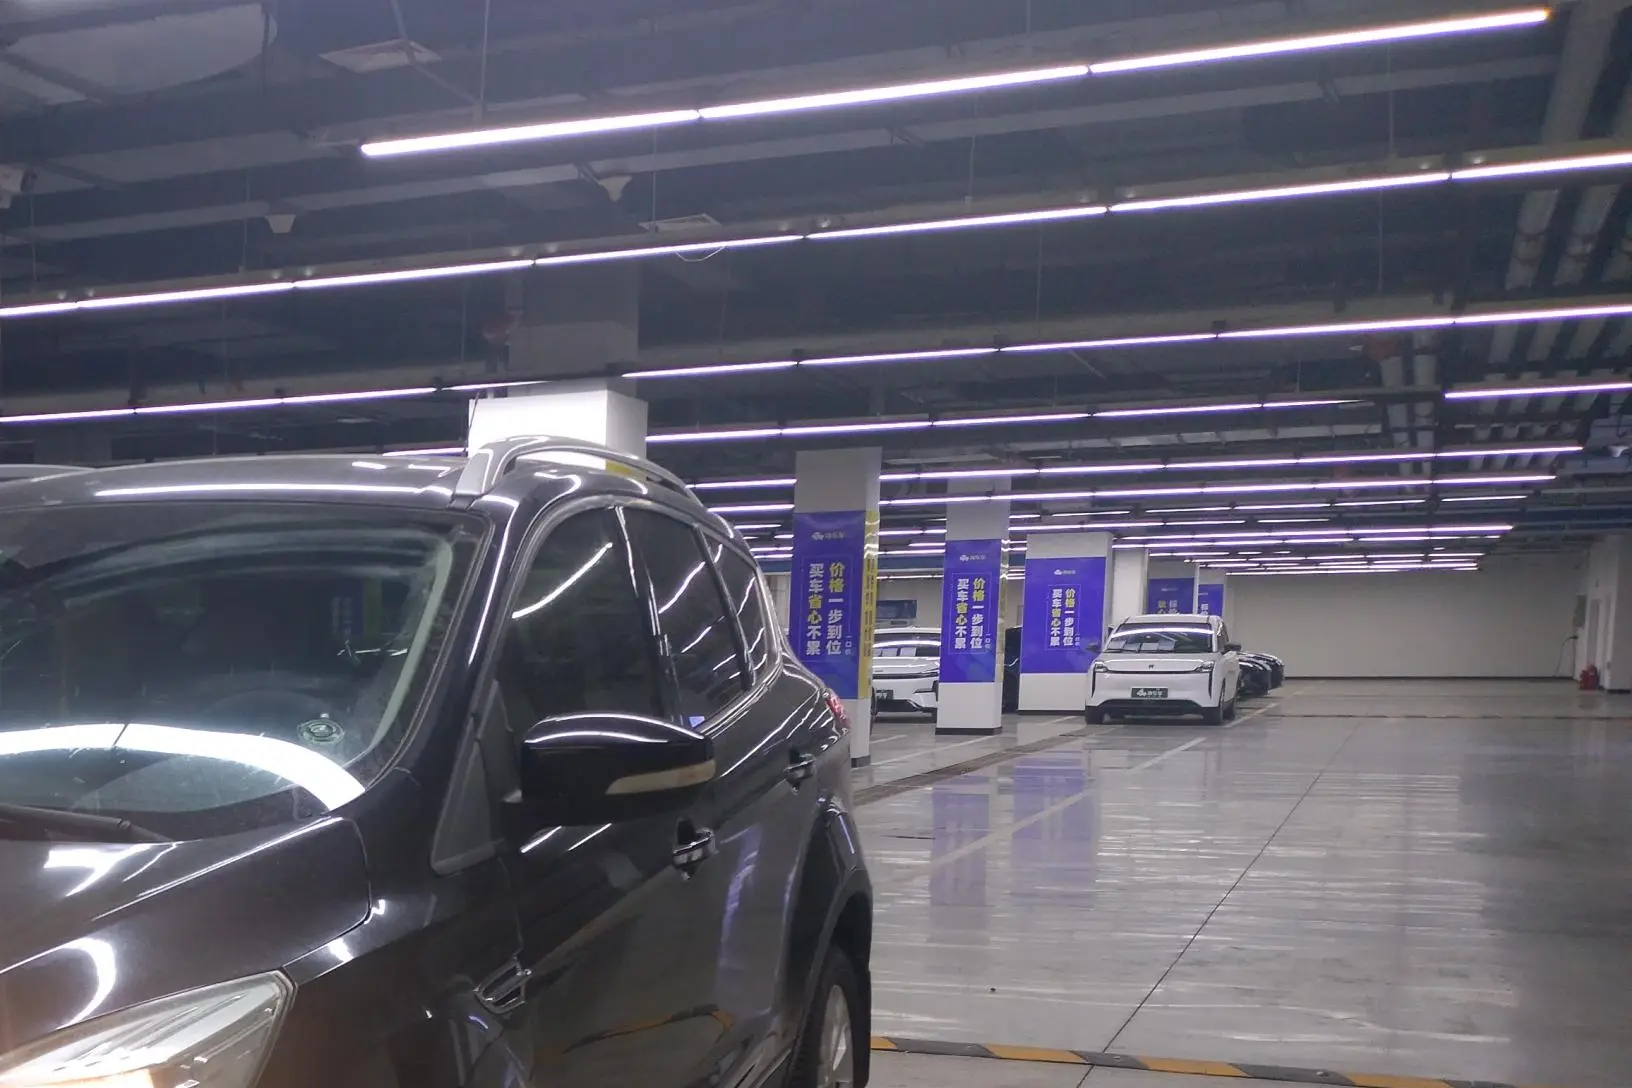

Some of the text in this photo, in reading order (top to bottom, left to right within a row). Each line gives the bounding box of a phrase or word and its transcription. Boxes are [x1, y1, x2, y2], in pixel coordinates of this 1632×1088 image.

[806, 563, 825, 655] 买车省心不累
[826, 561, 845, 655] 价格一步到位
